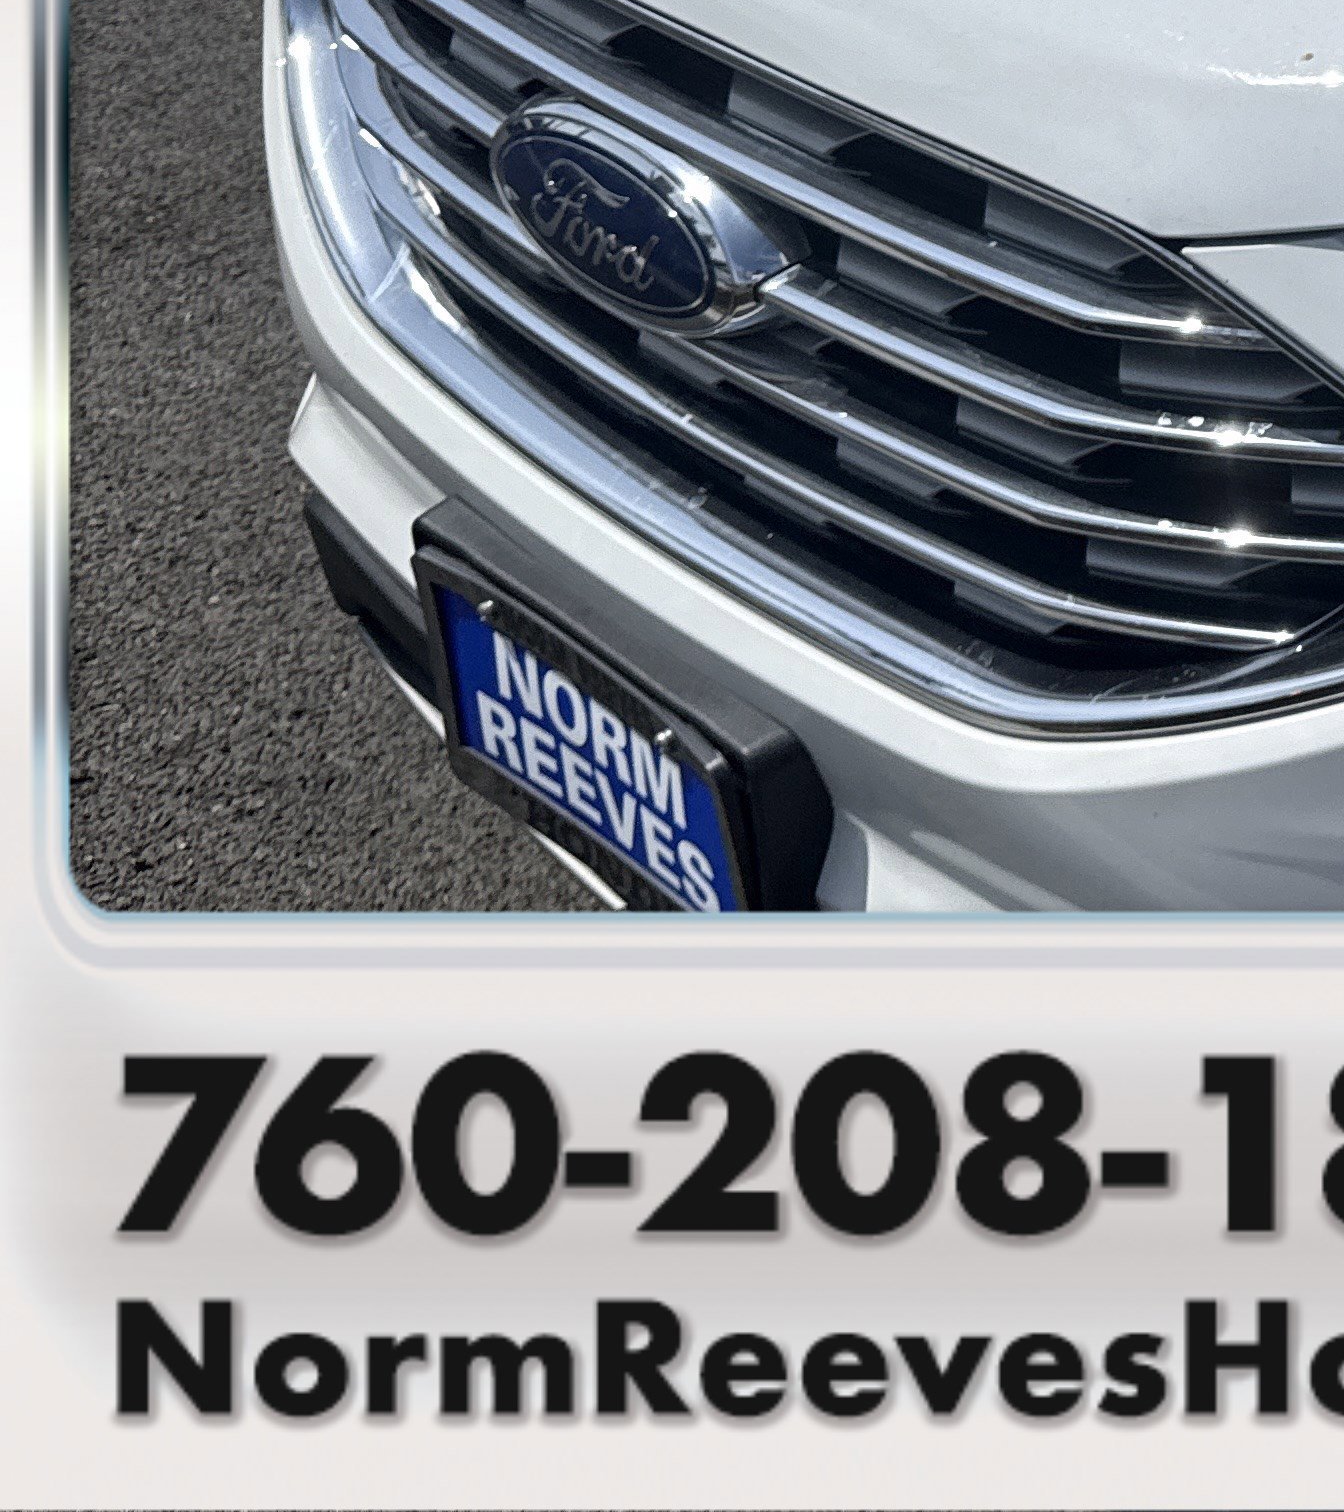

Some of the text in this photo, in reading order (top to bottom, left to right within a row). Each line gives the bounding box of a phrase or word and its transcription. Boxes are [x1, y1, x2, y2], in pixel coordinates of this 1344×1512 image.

[530, 158, 660, 291] Ford
[476, 691, 720, 912] REEVES
[493, 631, 687, 829] NORM
